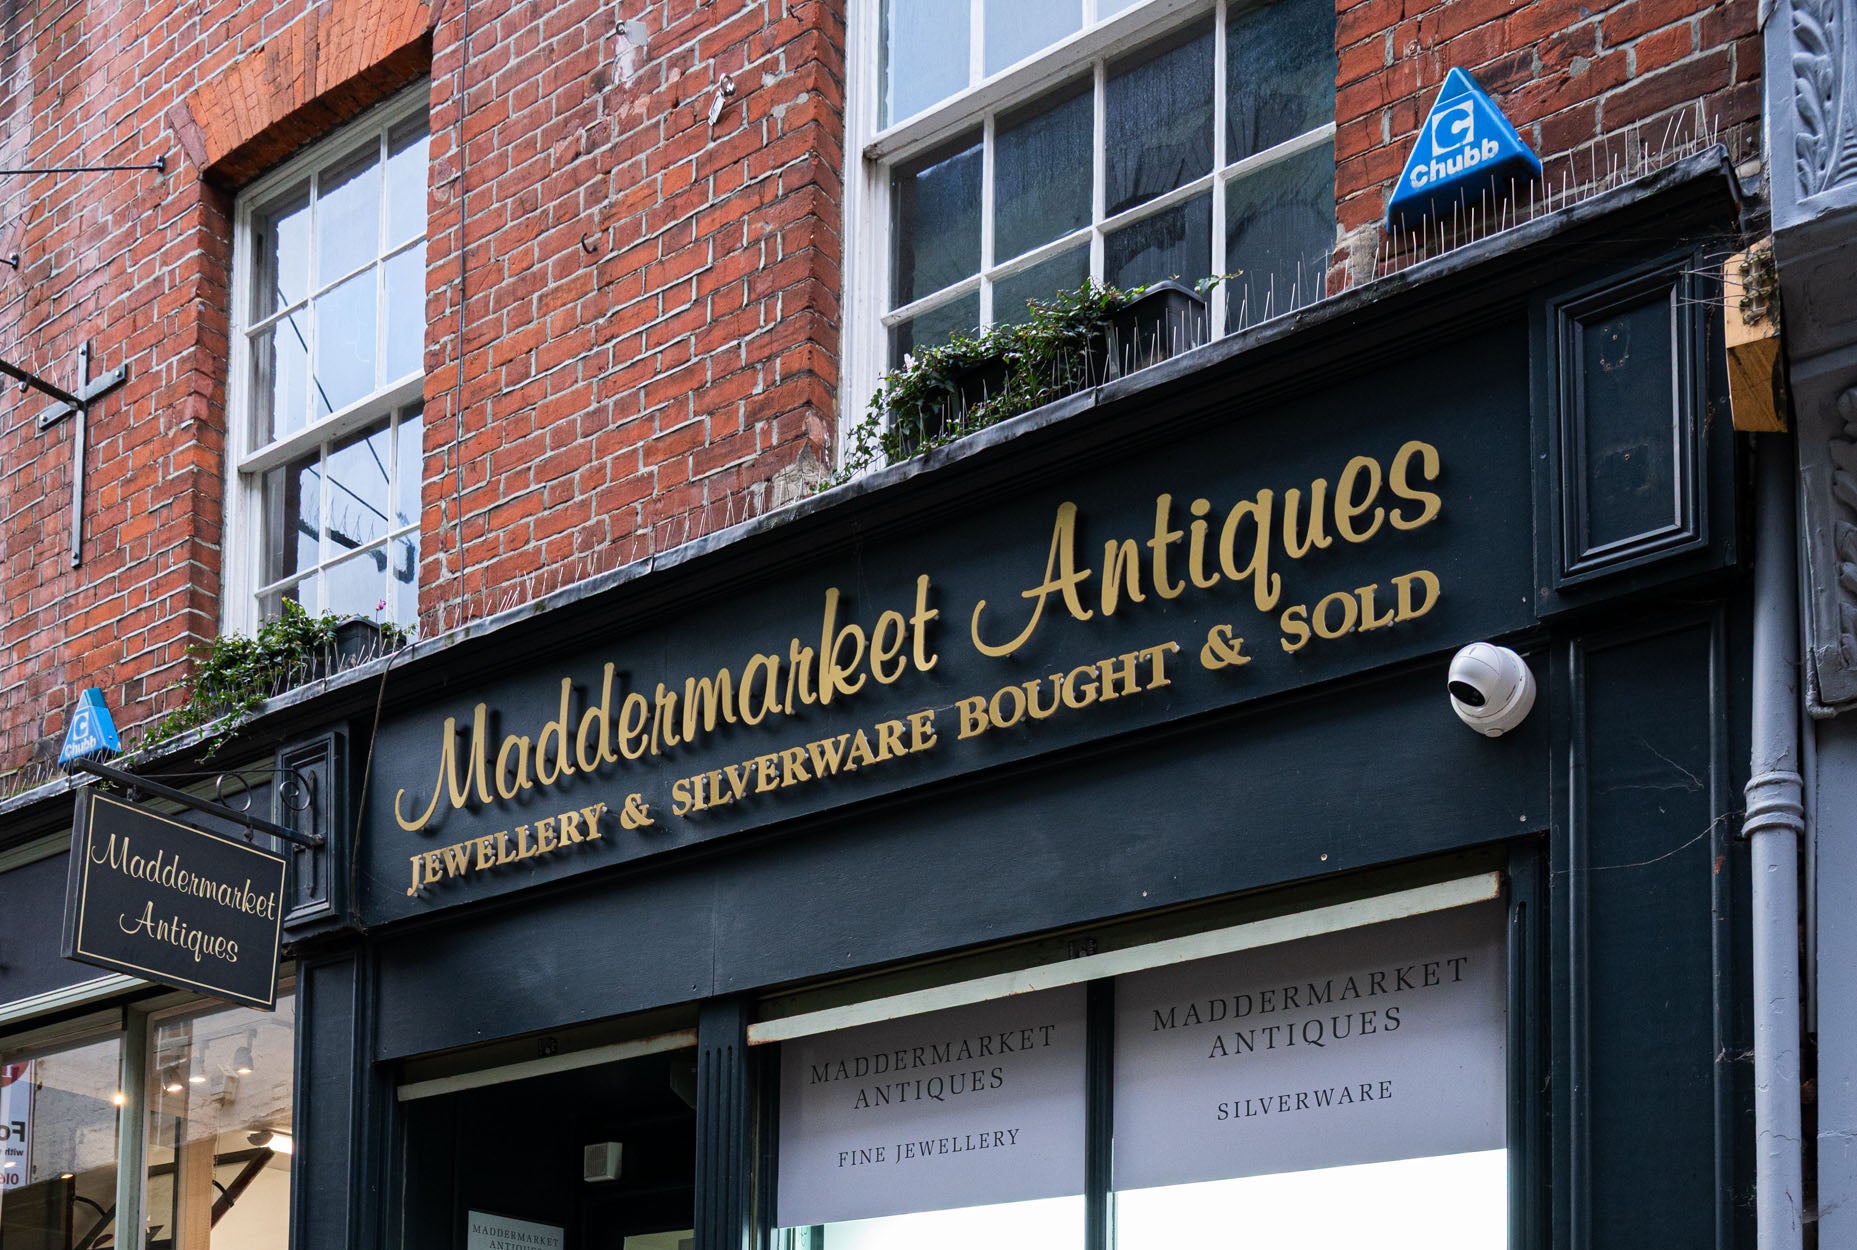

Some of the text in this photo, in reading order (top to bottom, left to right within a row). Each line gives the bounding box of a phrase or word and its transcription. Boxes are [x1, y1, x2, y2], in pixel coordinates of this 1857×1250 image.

[1410, 138, 1499, 188] Chubb
[395, 440, 1441, 831] Maddermarket Antiques
[407, 569, 1440, 897] JEWELLERY & SILVERWARE BOUGHT & SOLD
[91, 833, 276, 921] Maddermarket
[119, 901, 240, 962] Antiques
[1152, 956, 1470, 1031] MADDERMARKET
[810, 1024, 1057, 1084] MADDERMARKET
[1208, 1006, 1402, 1059] ANTIQUES
[854, 1067, 1005, 1110] ANTIQUES
[1217, 1080, 1393, 1121] SILVERWARE
[838, 1128, 1020, 1168] FINE JEWELLERY
[472, 1223, 559, 1247] MADDERMARKET
